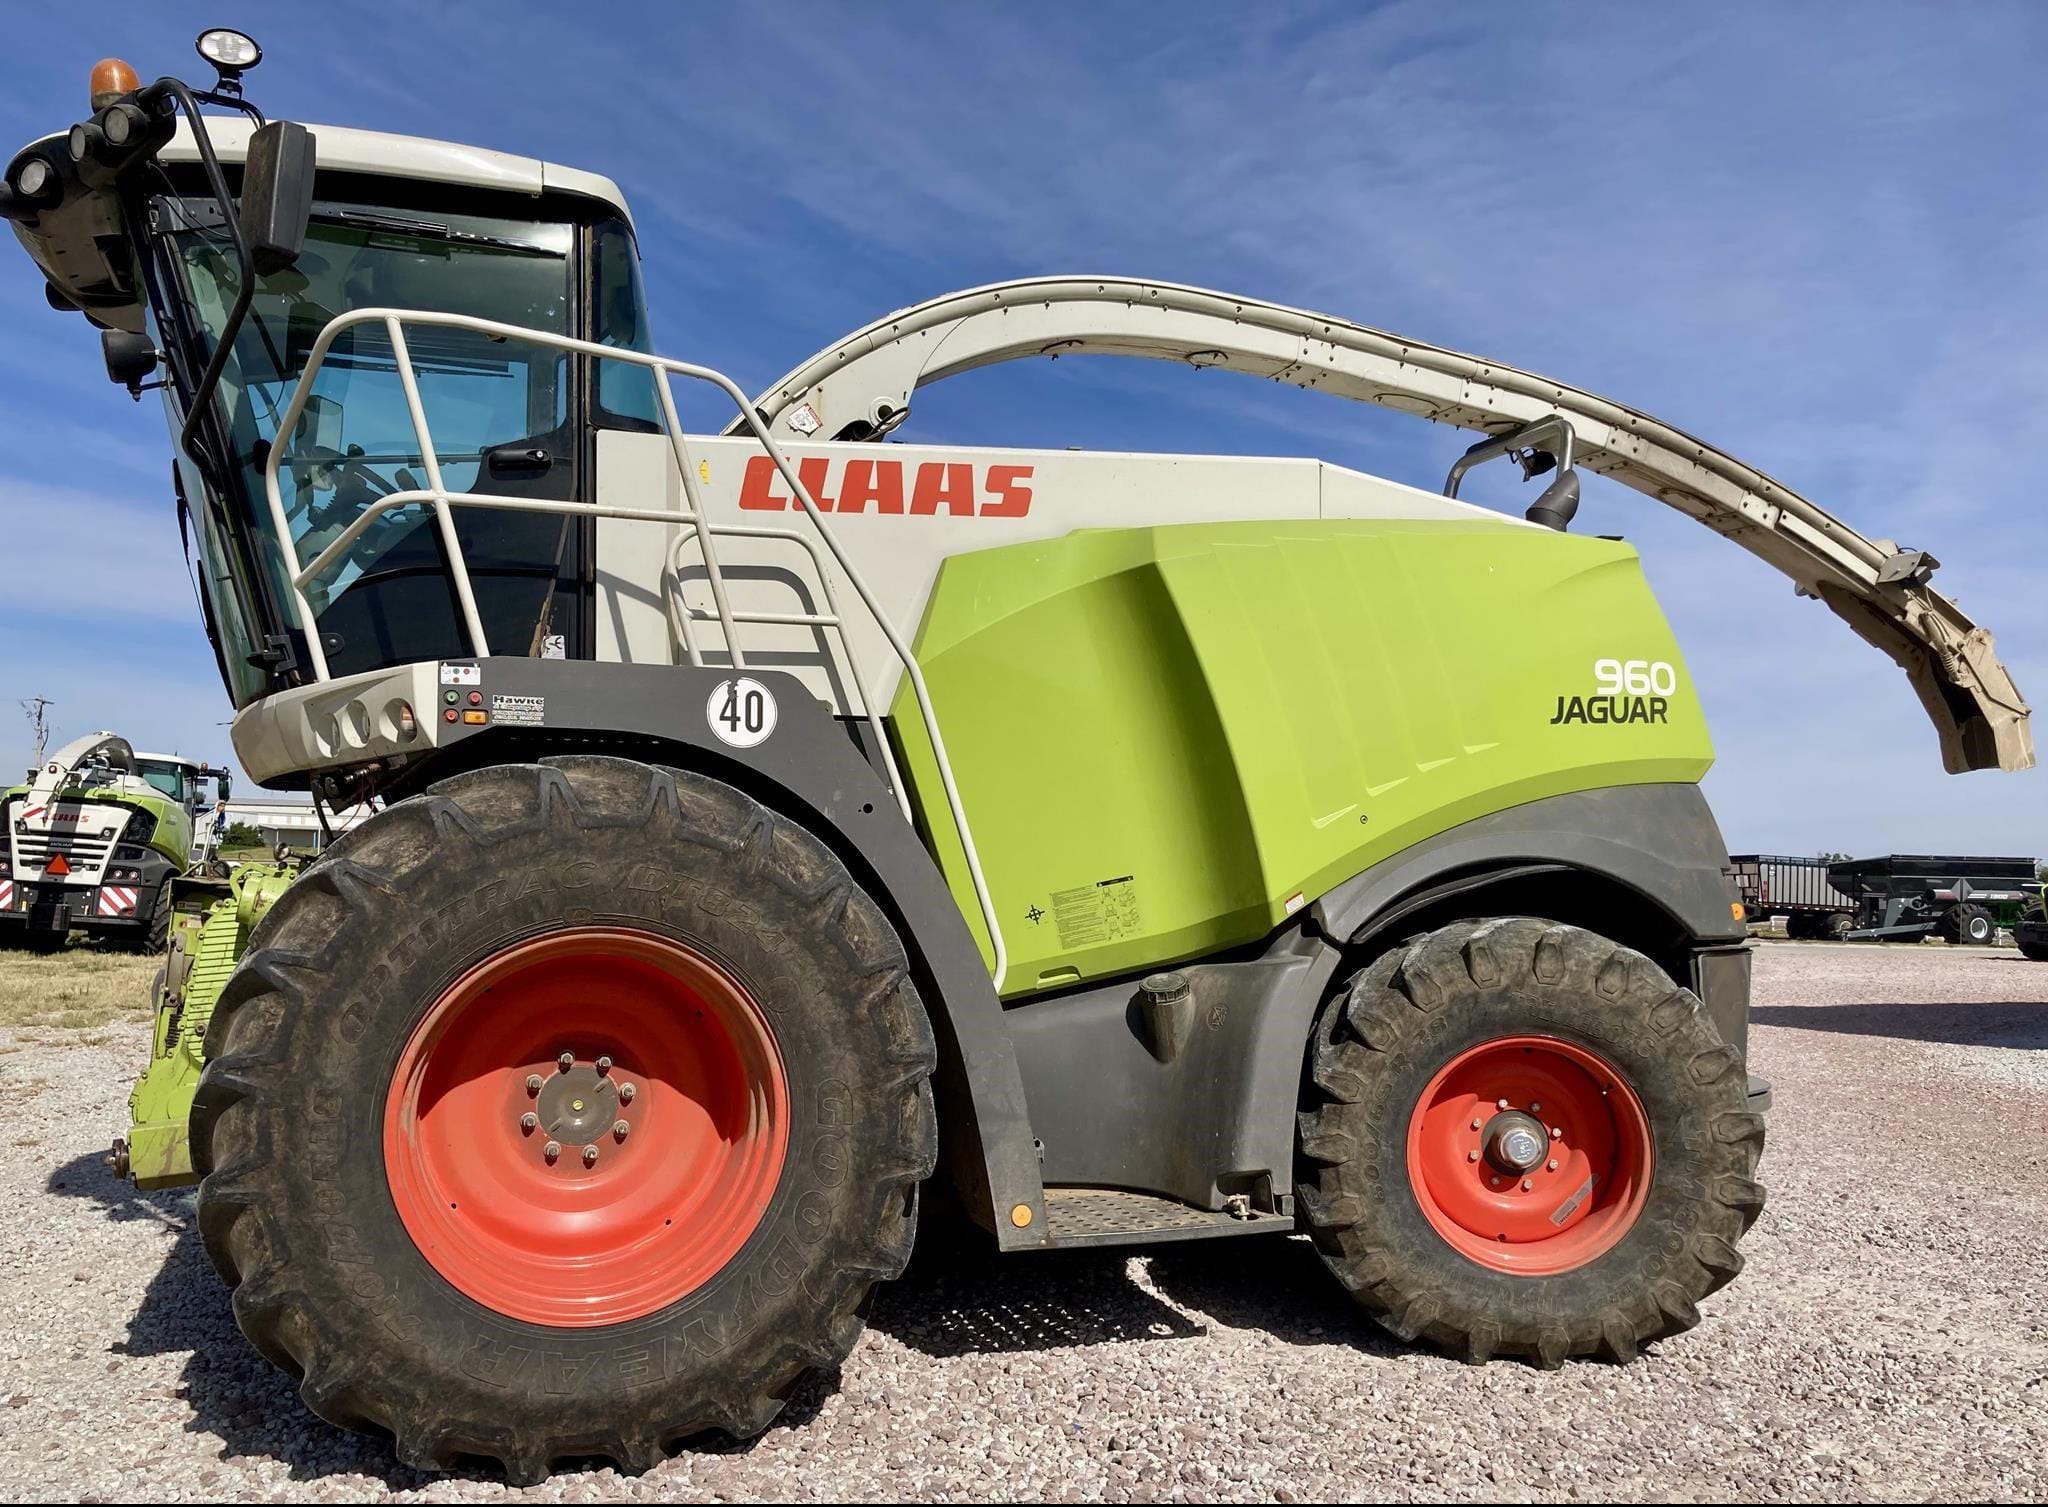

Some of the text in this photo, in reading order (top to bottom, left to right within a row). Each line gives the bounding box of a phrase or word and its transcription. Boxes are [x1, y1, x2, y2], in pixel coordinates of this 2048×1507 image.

[738, 455, 1034, 518] CLAAS
[1594, 658, 1677, 697] 960
[493, 695, 543, 705] Hawke
[719, 689, 764, 733] 40
[1549, 696, 1669, 725] JAGUAR
[339, 860, 787, 1044] OPTITRAC DT824
[1641, 1130, 1708, 1280] TM800
